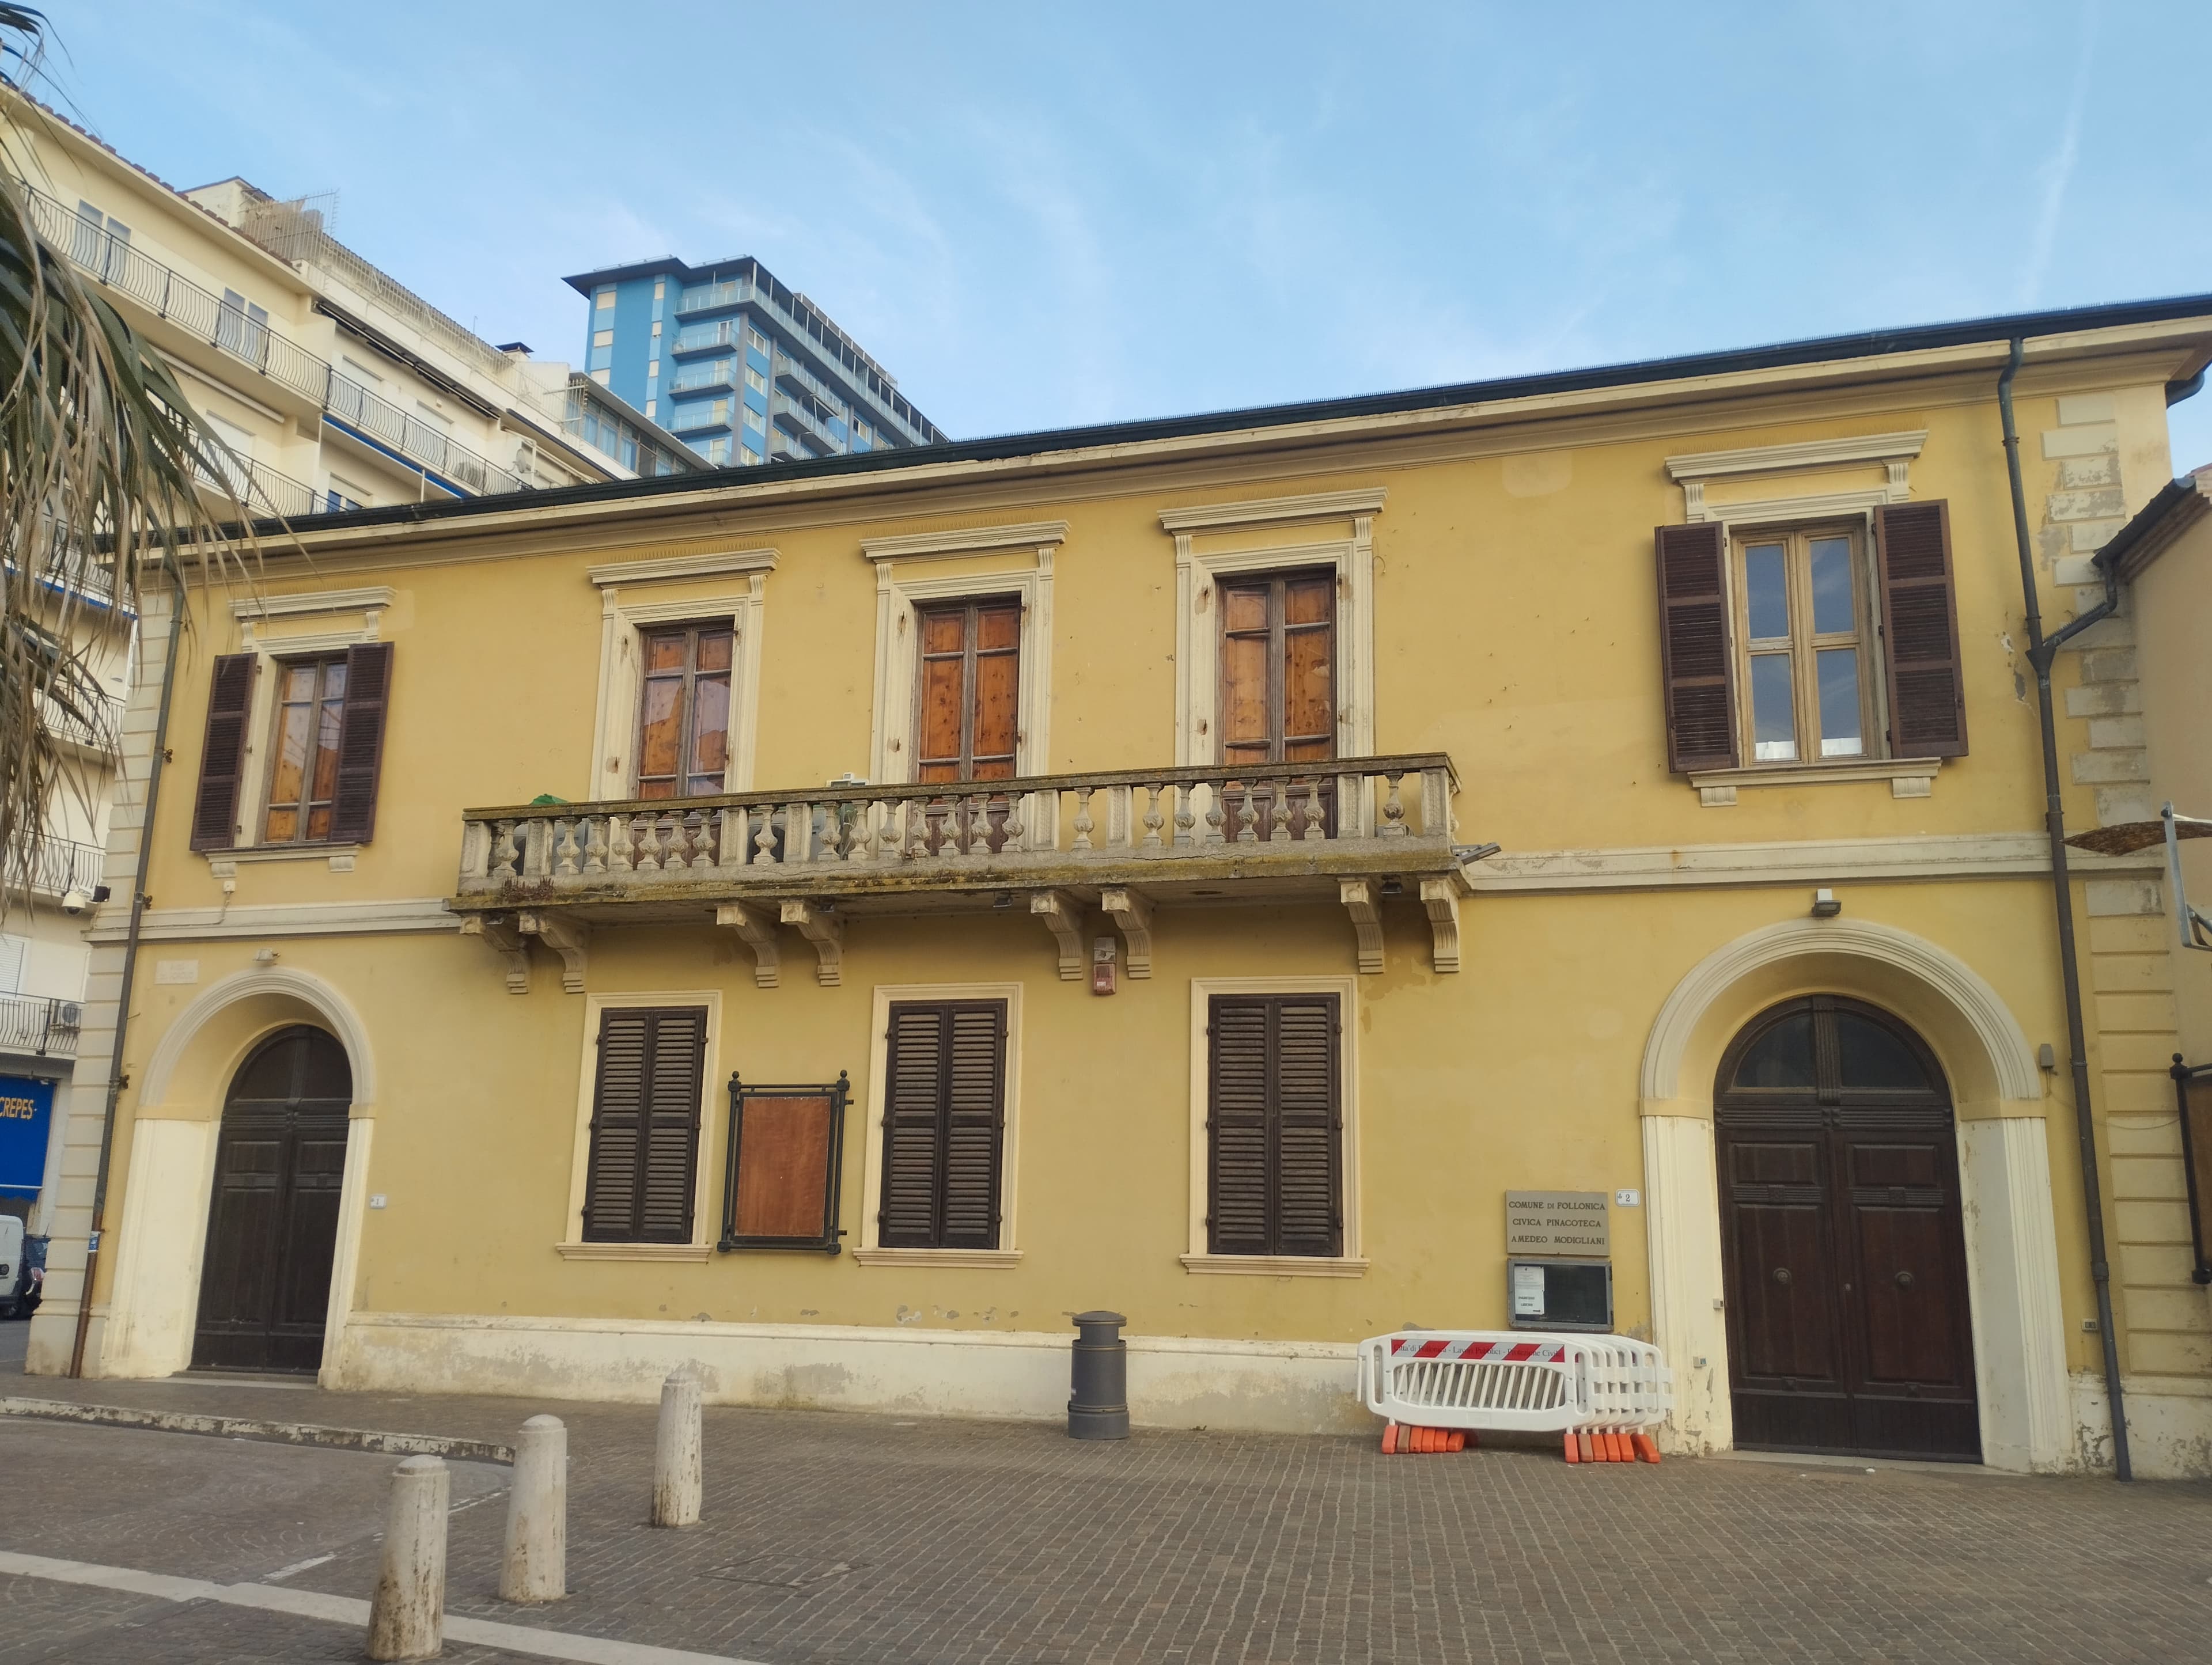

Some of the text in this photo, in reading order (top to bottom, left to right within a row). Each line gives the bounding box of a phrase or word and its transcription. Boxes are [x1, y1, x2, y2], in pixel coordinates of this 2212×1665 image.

[1626, 1193, 1631, 1203] 2
[1509, 1201, 1544, 1209] COMUNE
[1557, 1202, 1605, 1210] FOLLONICA
[1512, 1218, 1601, 1227] CIVICA PINACOTECA
[1554, 1236, 1605, 1245] MODIGLIANI
